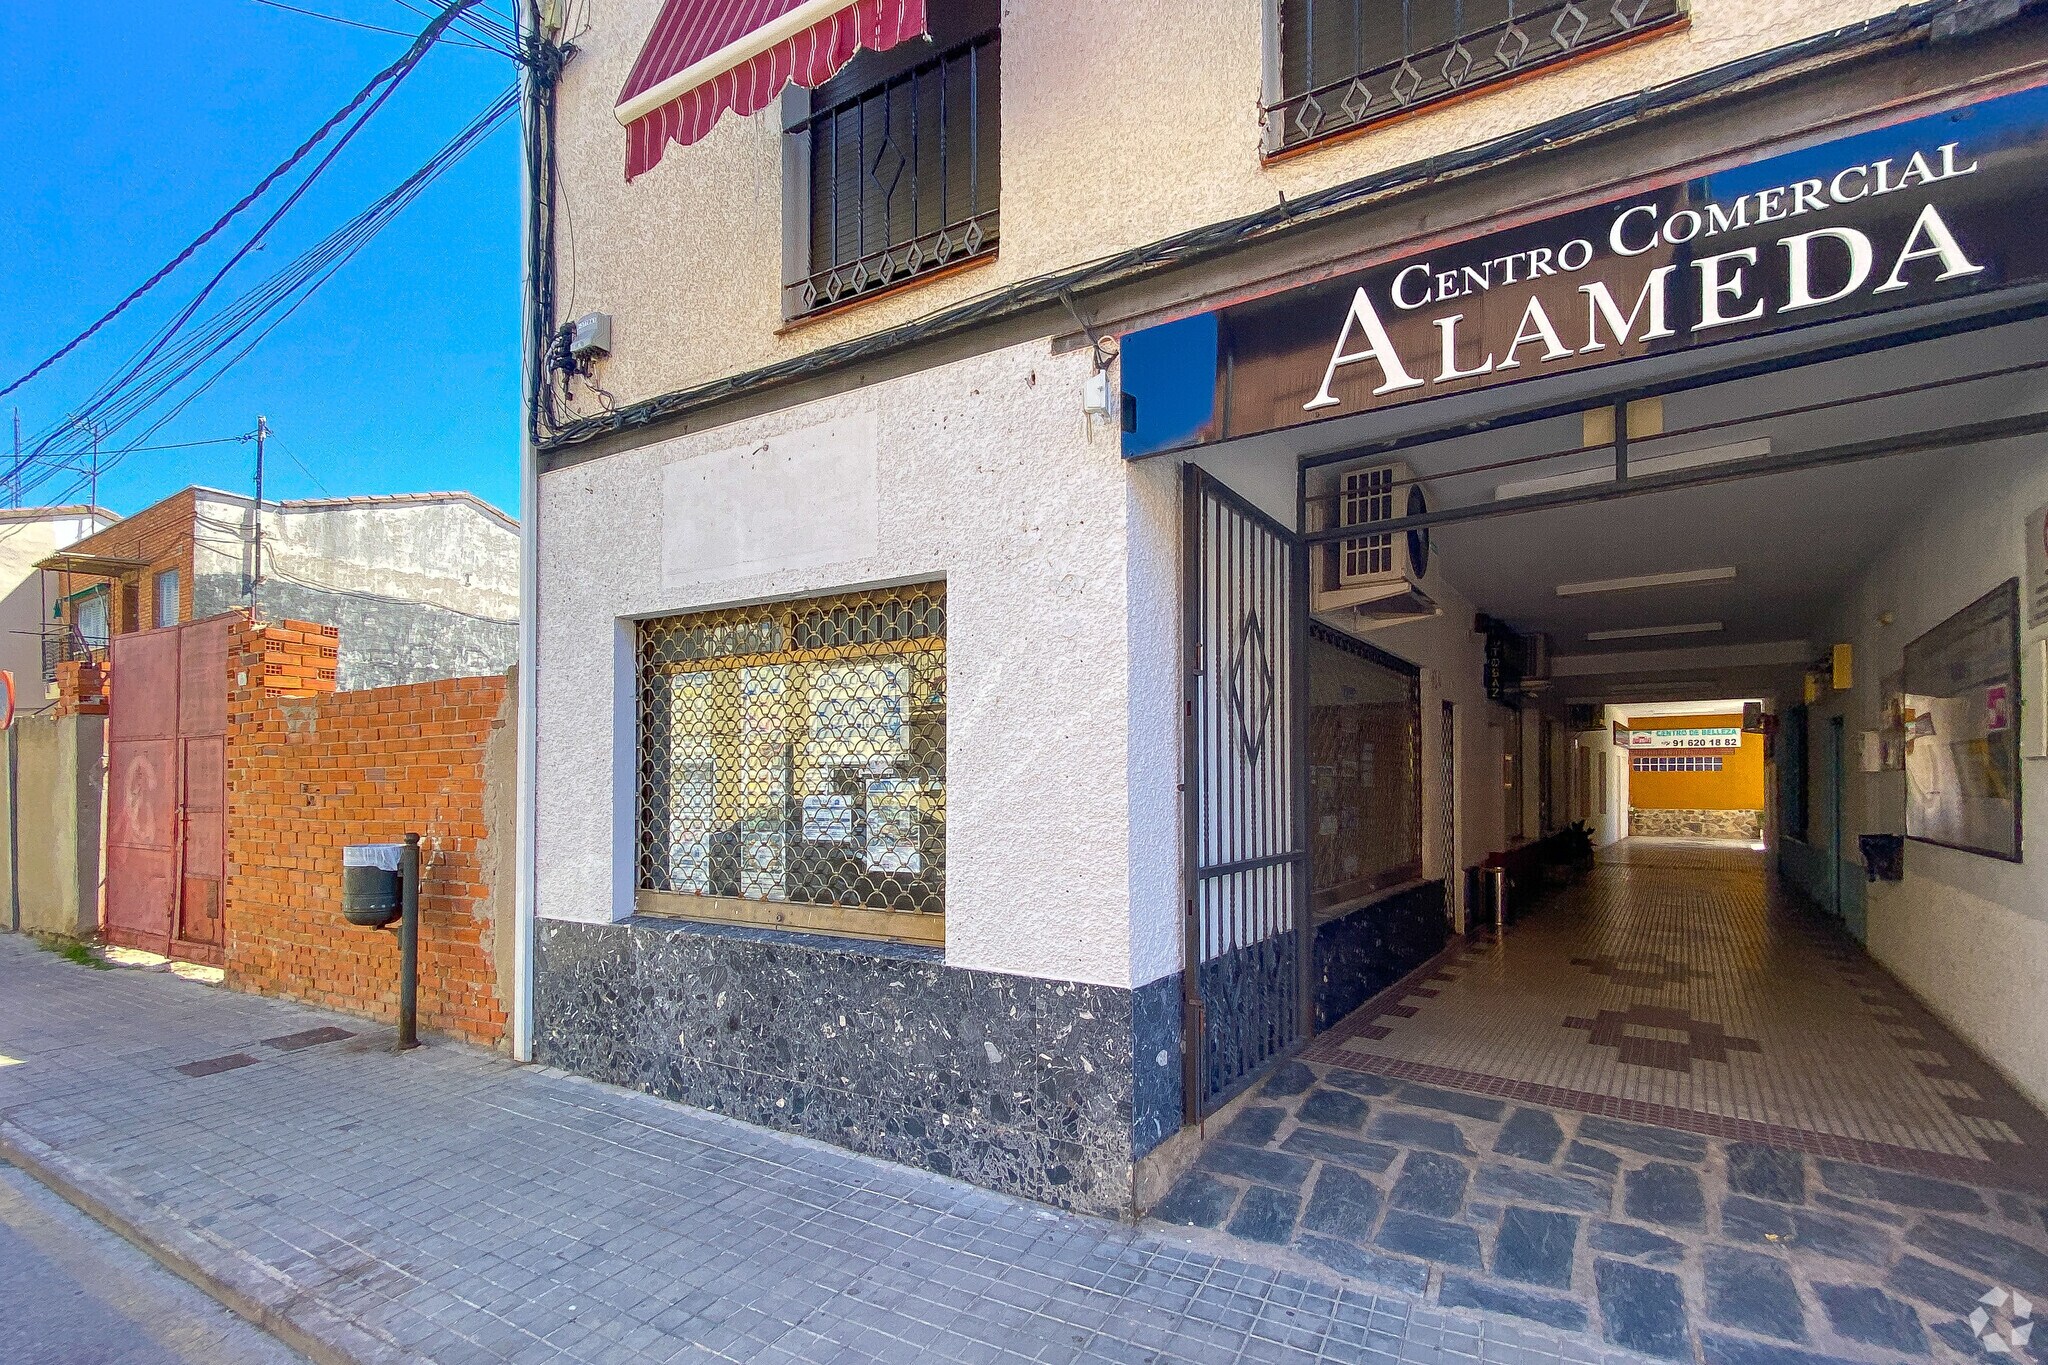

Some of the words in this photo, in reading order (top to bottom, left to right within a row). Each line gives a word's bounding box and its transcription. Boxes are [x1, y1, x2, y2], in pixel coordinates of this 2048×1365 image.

[1391, 239, 1593, 310] CENTRO
[1609, 142, 1978, 256] COMERCIAL
[1302, 202, 1984, 411] ALAMEDA
[1672, 739, 1684, 747] 91
[1687, 739, 1706, 747] 620
[1724, 738, 1737, 746] 82
[1701, 728, 1737, 736] BELLEZA
